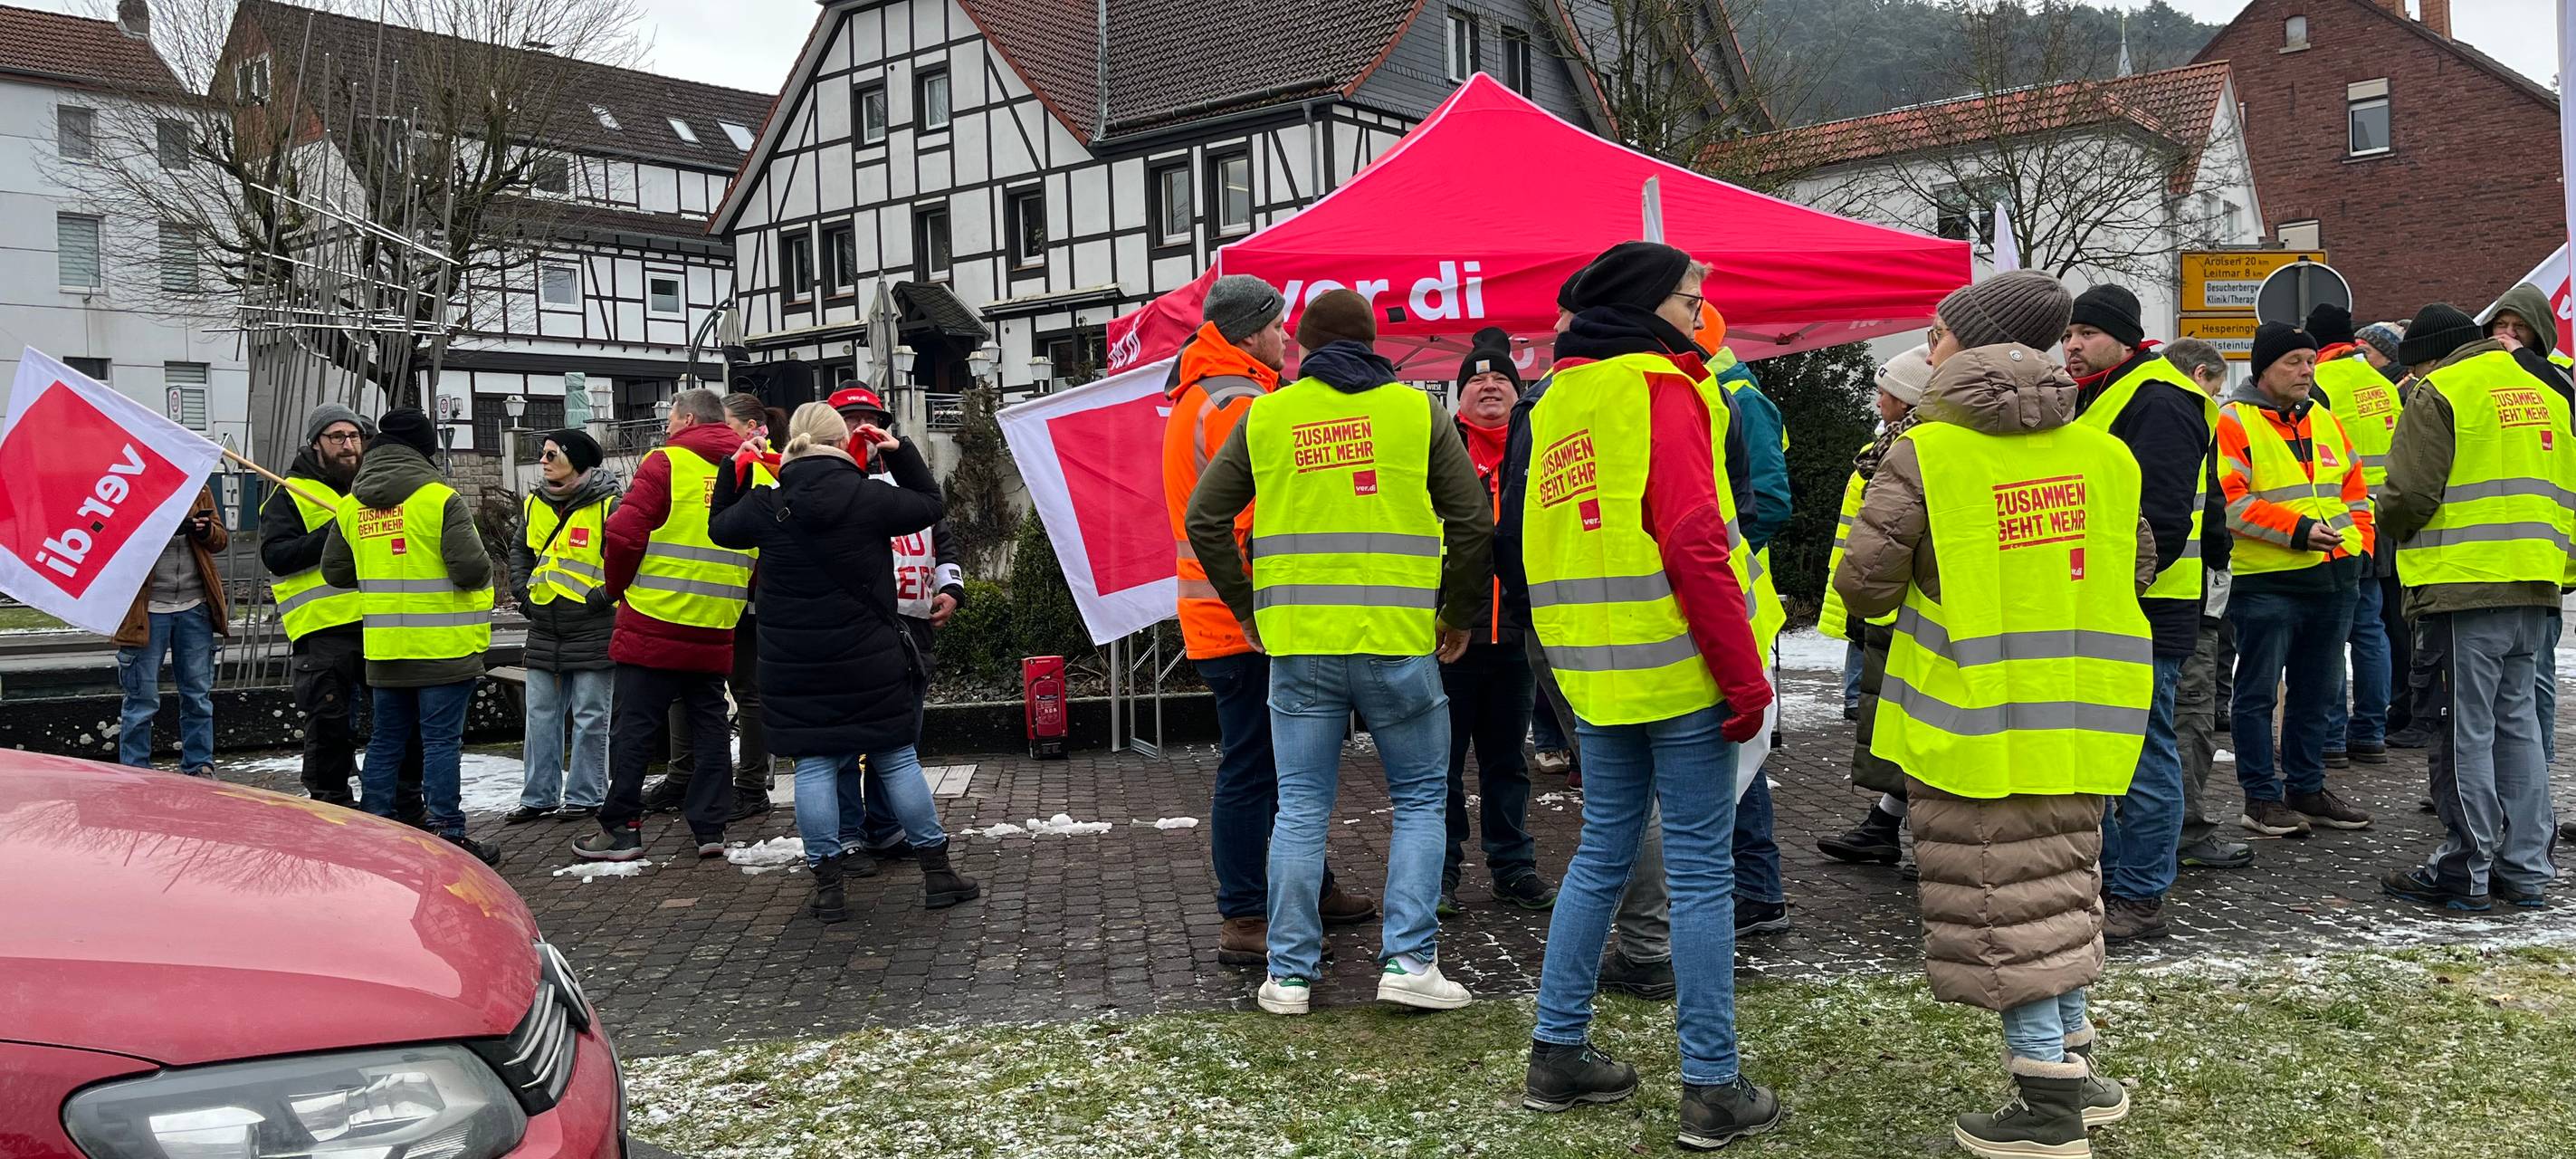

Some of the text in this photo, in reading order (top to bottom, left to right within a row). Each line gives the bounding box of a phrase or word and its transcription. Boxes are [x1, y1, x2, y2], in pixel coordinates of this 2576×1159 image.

[2245, 256, 2256, 266] 20
[2203, 269, 2241, 278] Leitmar
[2245, 268, 2250, 277] 8
[2524, 406, 2550, 420] MEHR
[1292, 421, 1372, 448] ZUSAMMEN
[1294, 440, 1374, 466] GEHT MEHR
[1355, 484, 1376, 492] ver.di
[1994, 482, 2085, 517] ZUSAMMEN
[358, 518, 404, 536] GEHT MEHR
[2049, 509, 2085, 534] MEHR
